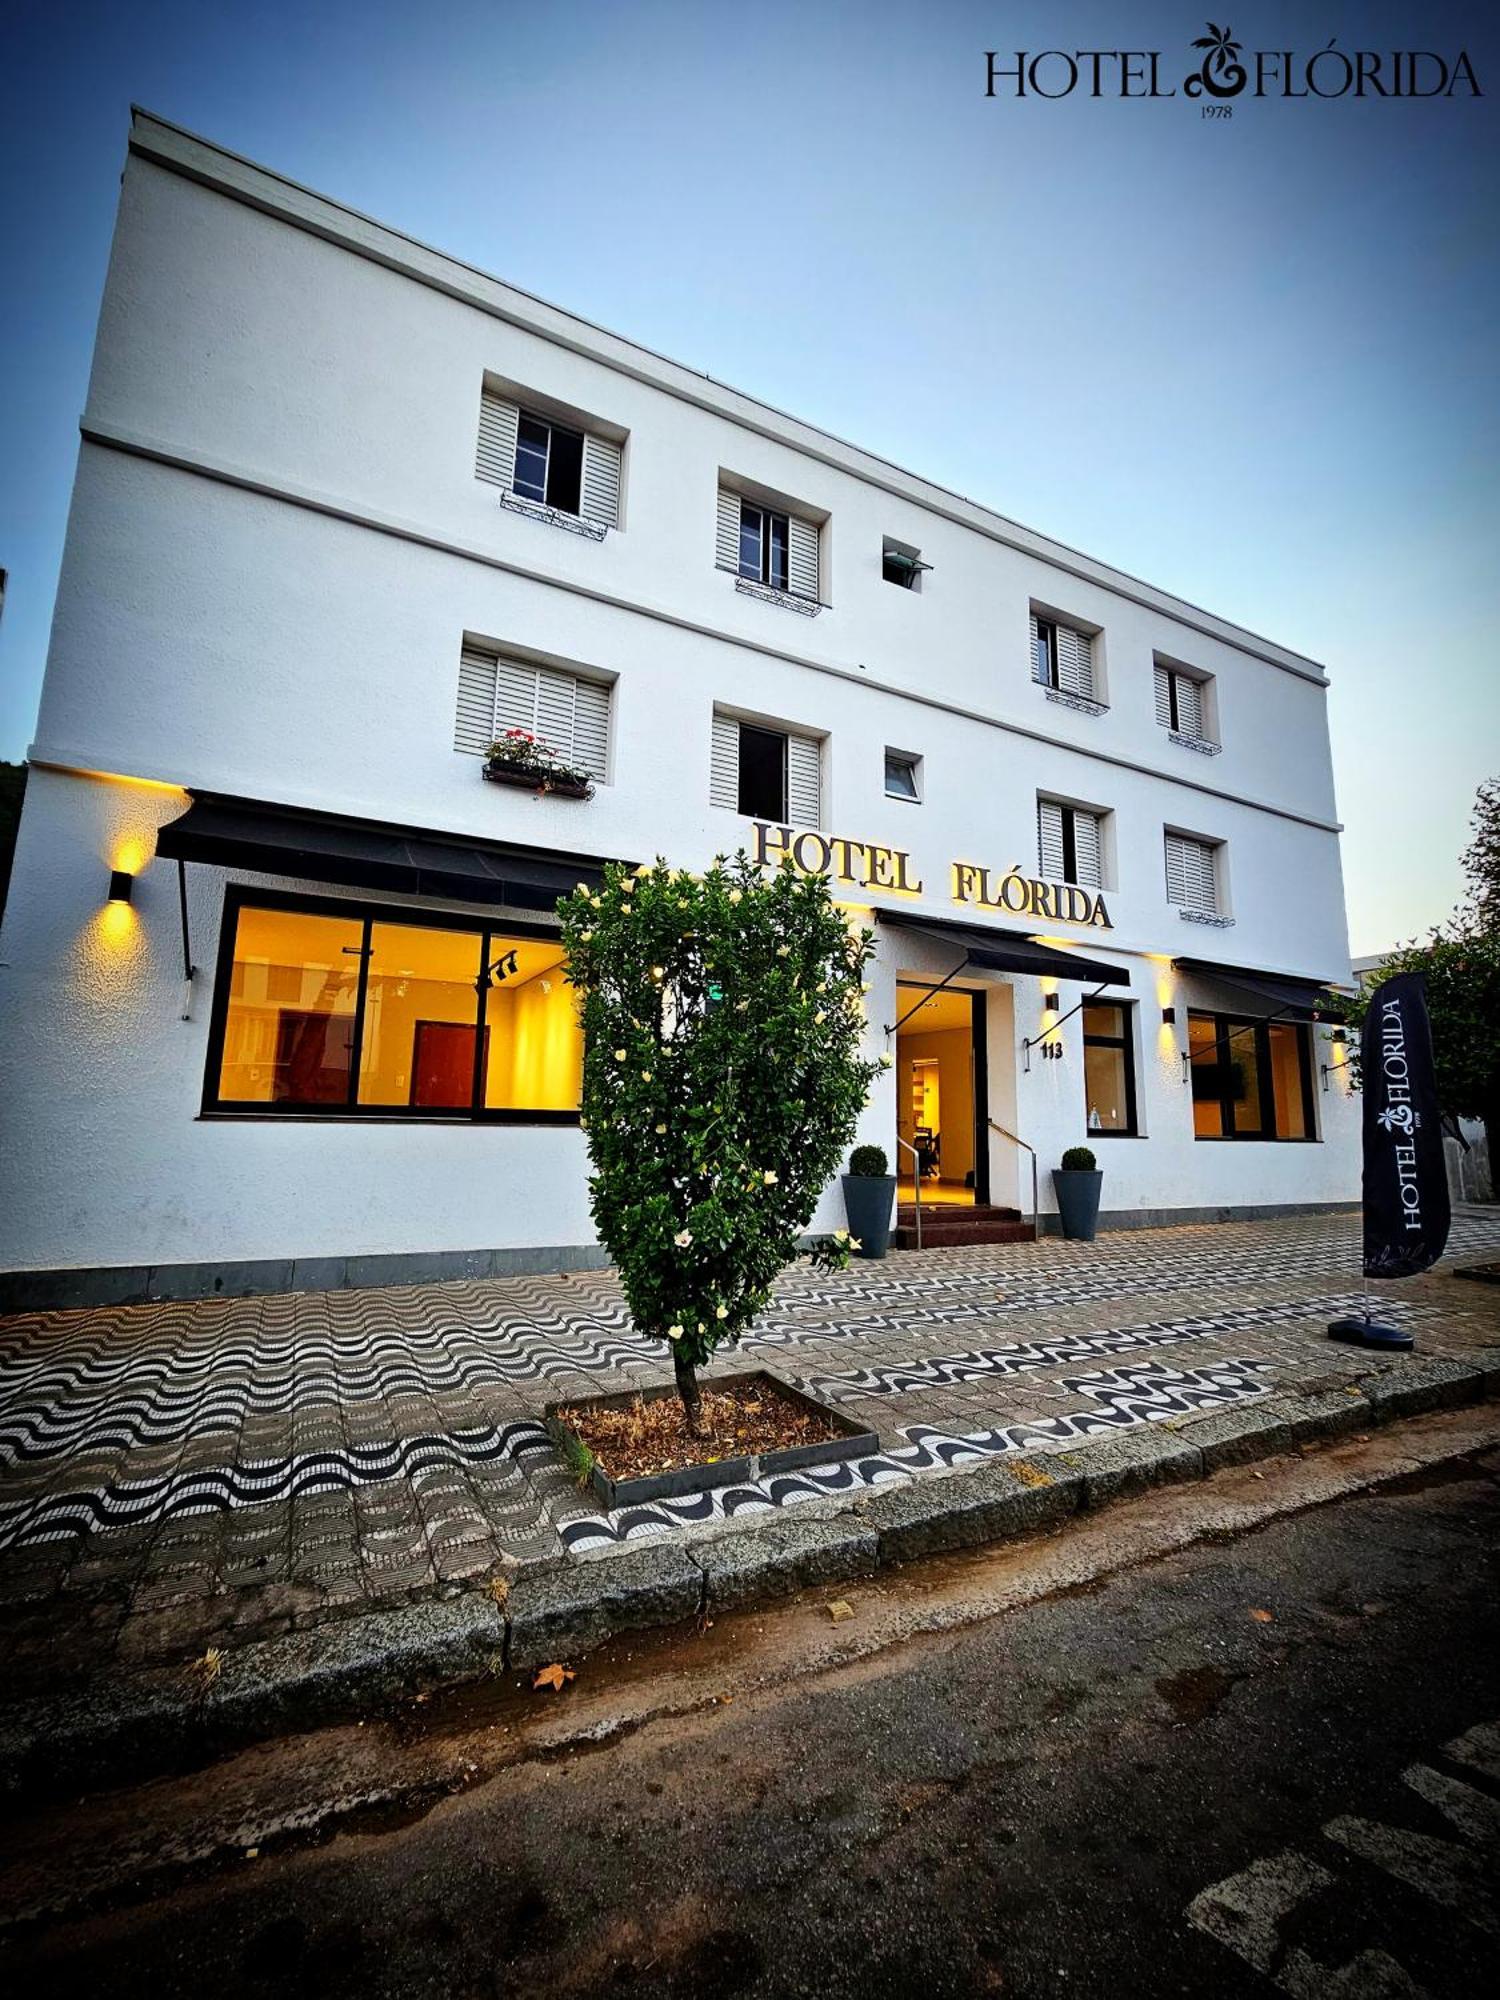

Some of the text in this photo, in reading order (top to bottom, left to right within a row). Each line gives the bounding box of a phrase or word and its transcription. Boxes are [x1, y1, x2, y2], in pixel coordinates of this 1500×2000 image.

[753, 822, 1114, 928] HOTEL FLÓRIDA
[1040, 1042, 1063, 1060] 113
[1396, 1138, 1421, 1229] HOTEL
